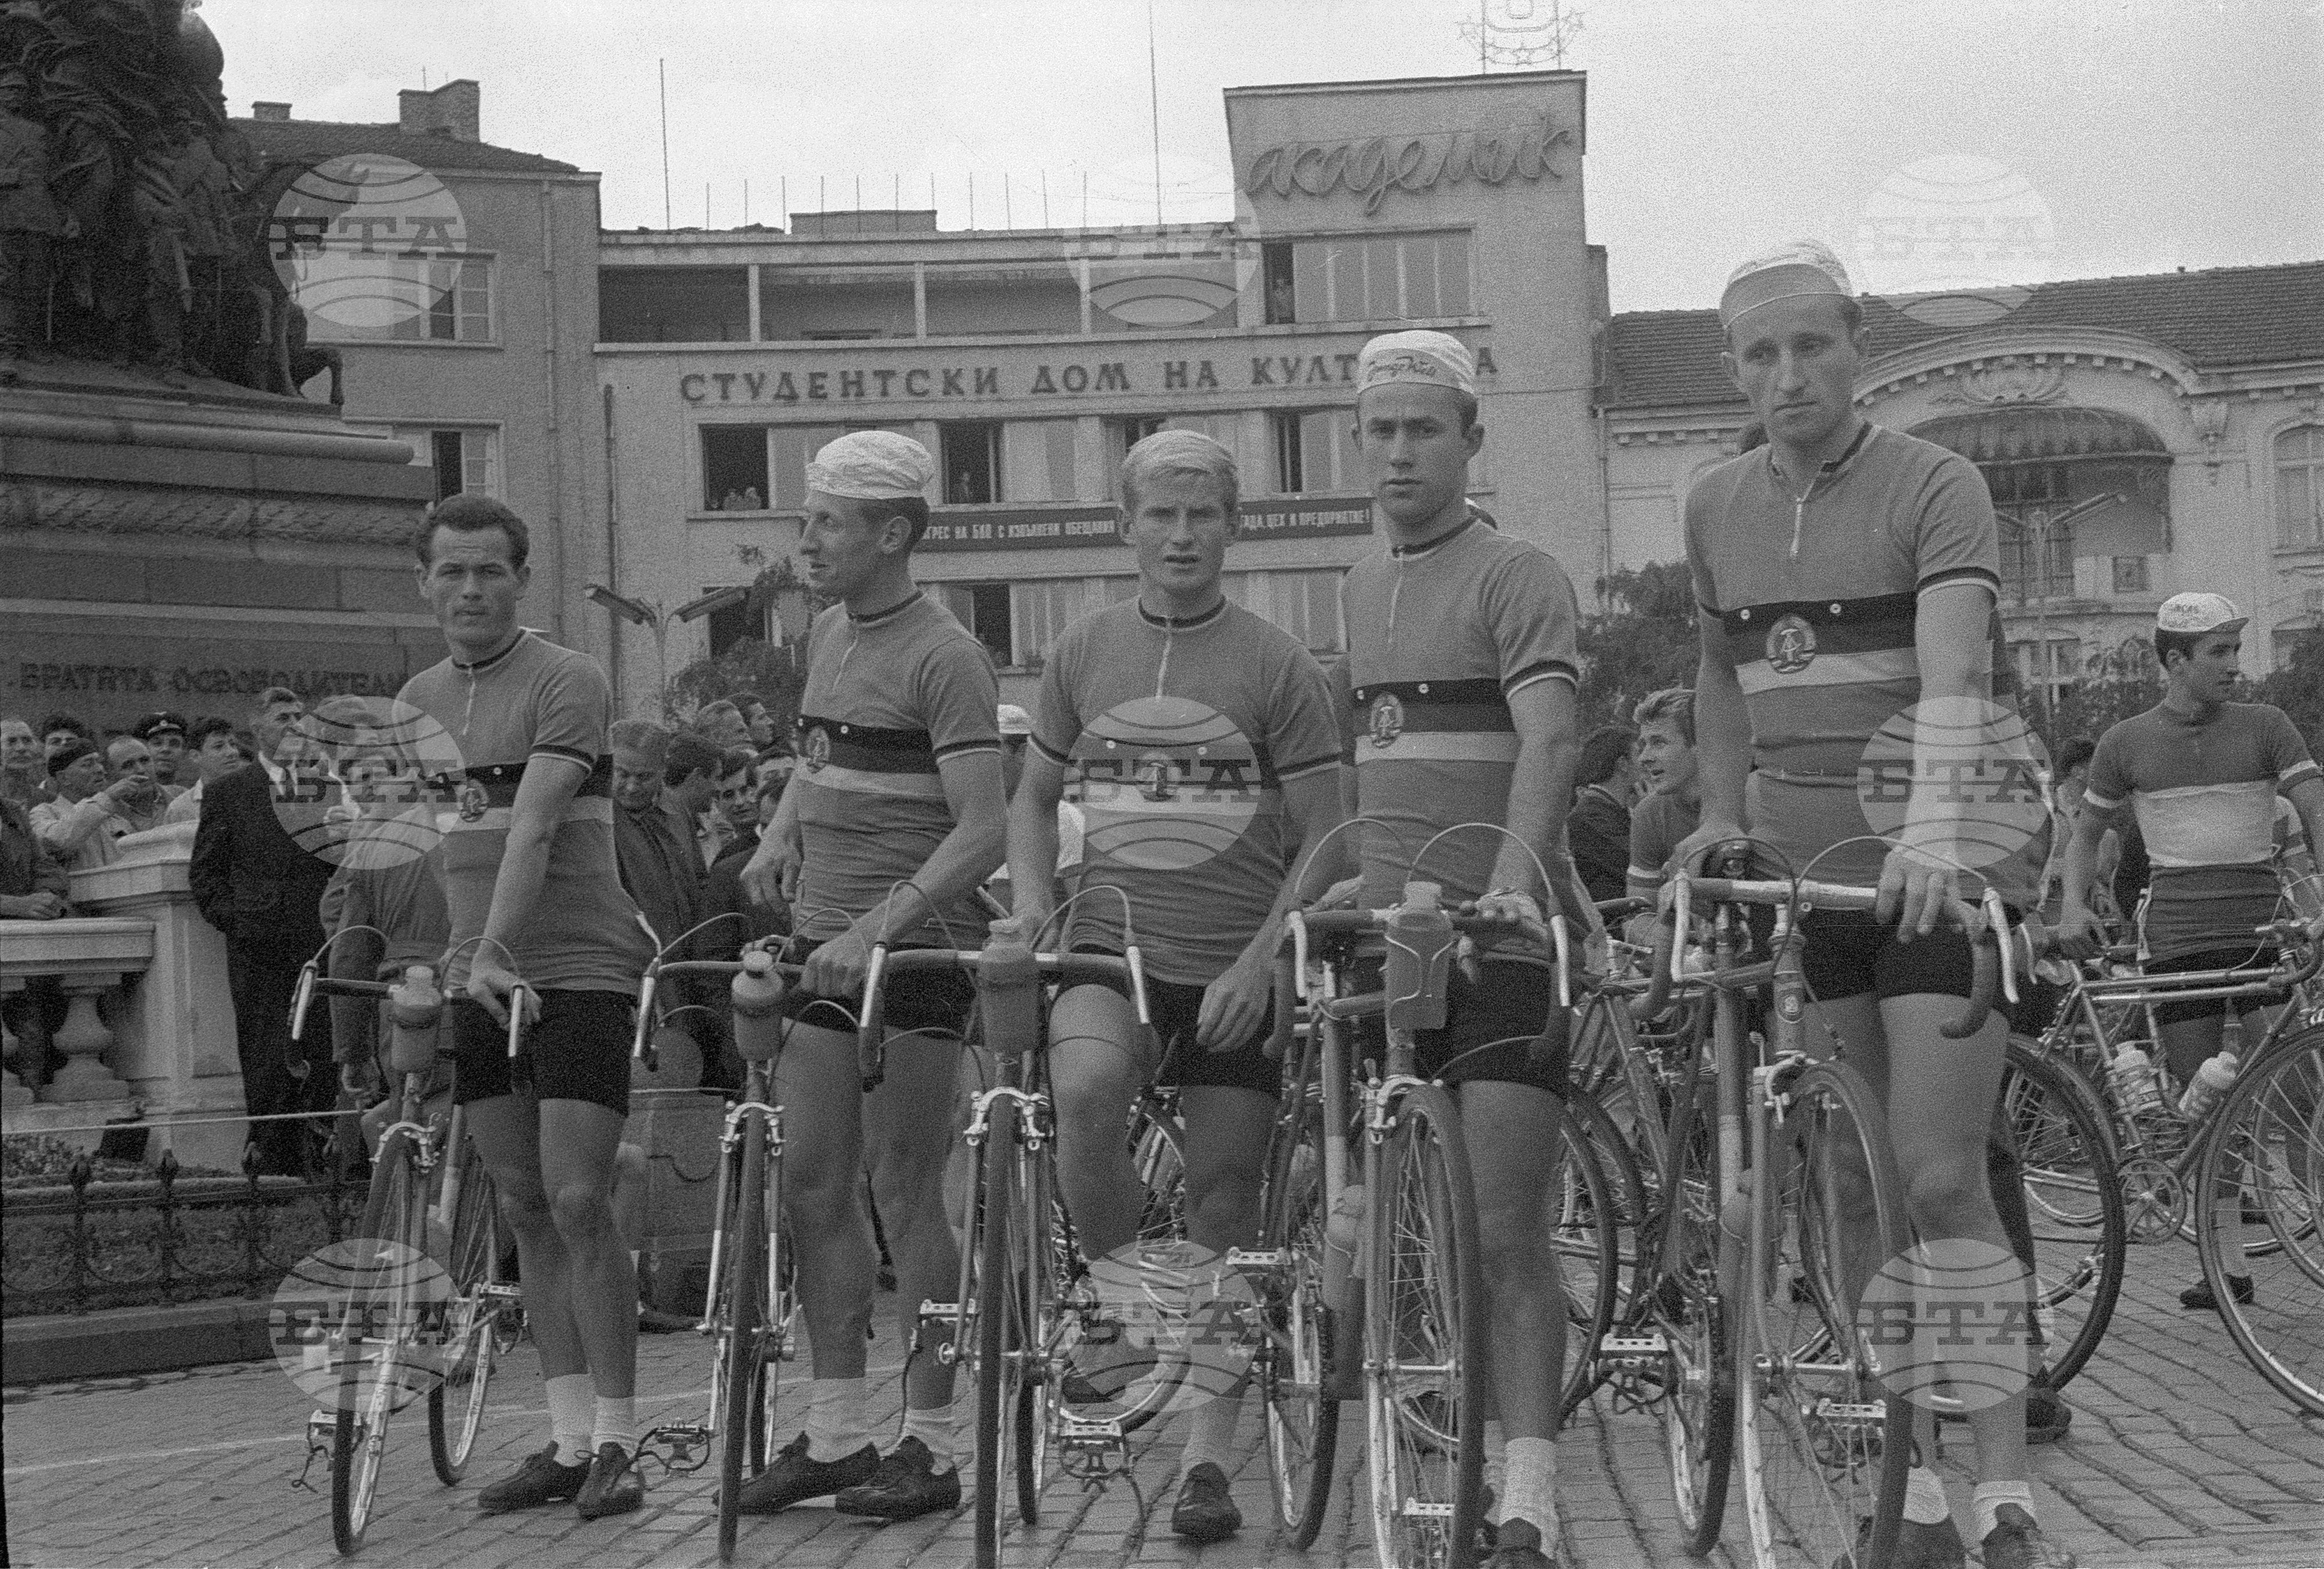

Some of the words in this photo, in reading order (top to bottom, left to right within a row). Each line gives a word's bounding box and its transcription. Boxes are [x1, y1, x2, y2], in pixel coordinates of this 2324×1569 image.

[679, 367, 999, 403] СТУДЕНТСКИ
[1031, 361, 1131, 395] ДОМ
[1163, 359, 1218, 389] НА
[1250, 346, 1498, 385] КУЛТА
